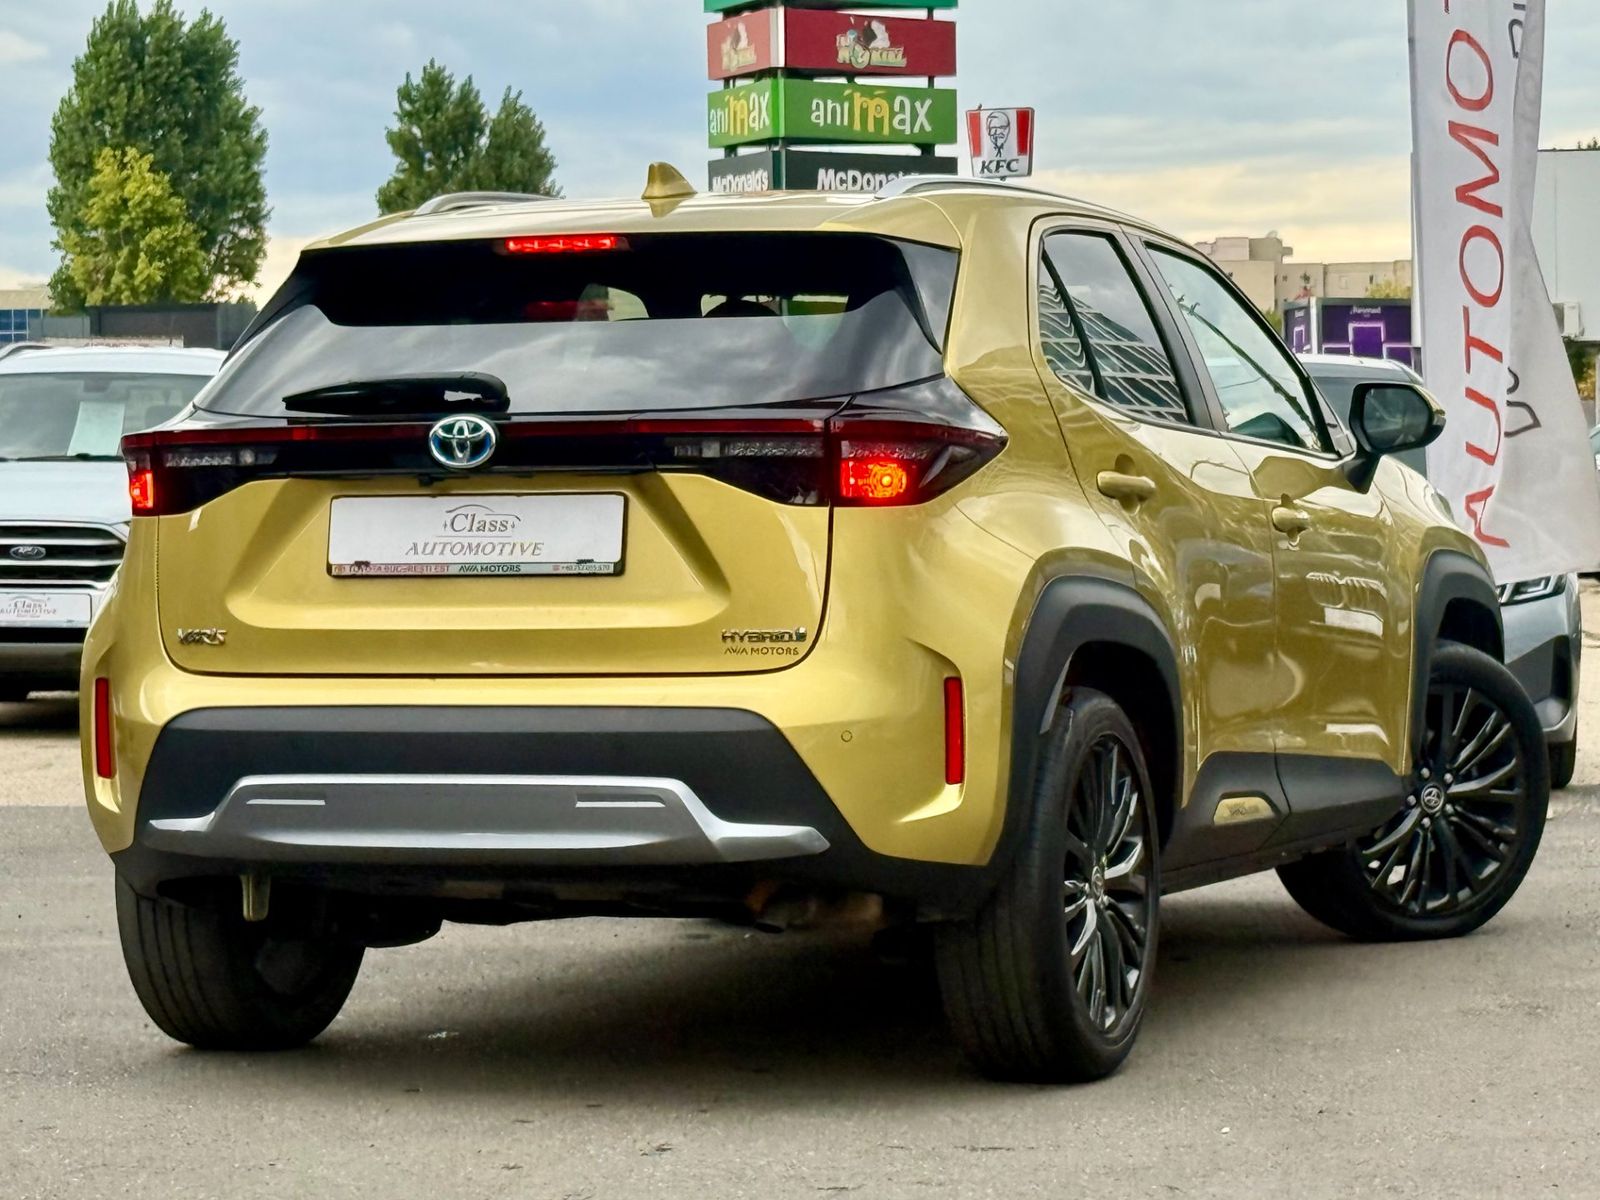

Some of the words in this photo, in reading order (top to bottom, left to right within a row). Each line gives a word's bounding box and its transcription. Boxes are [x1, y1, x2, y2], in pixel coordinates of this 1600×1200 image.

[979, 158, 1020, 174] KFC
[1443, 0, 1510, 548] AUTOMO
[449, 512, 509, 533] Class
[405, 541, 545, 557] AUTOMOTIVE
[480, 563, 521, 573] MOTORS
[750, 646, 800, 656] MOTORS
